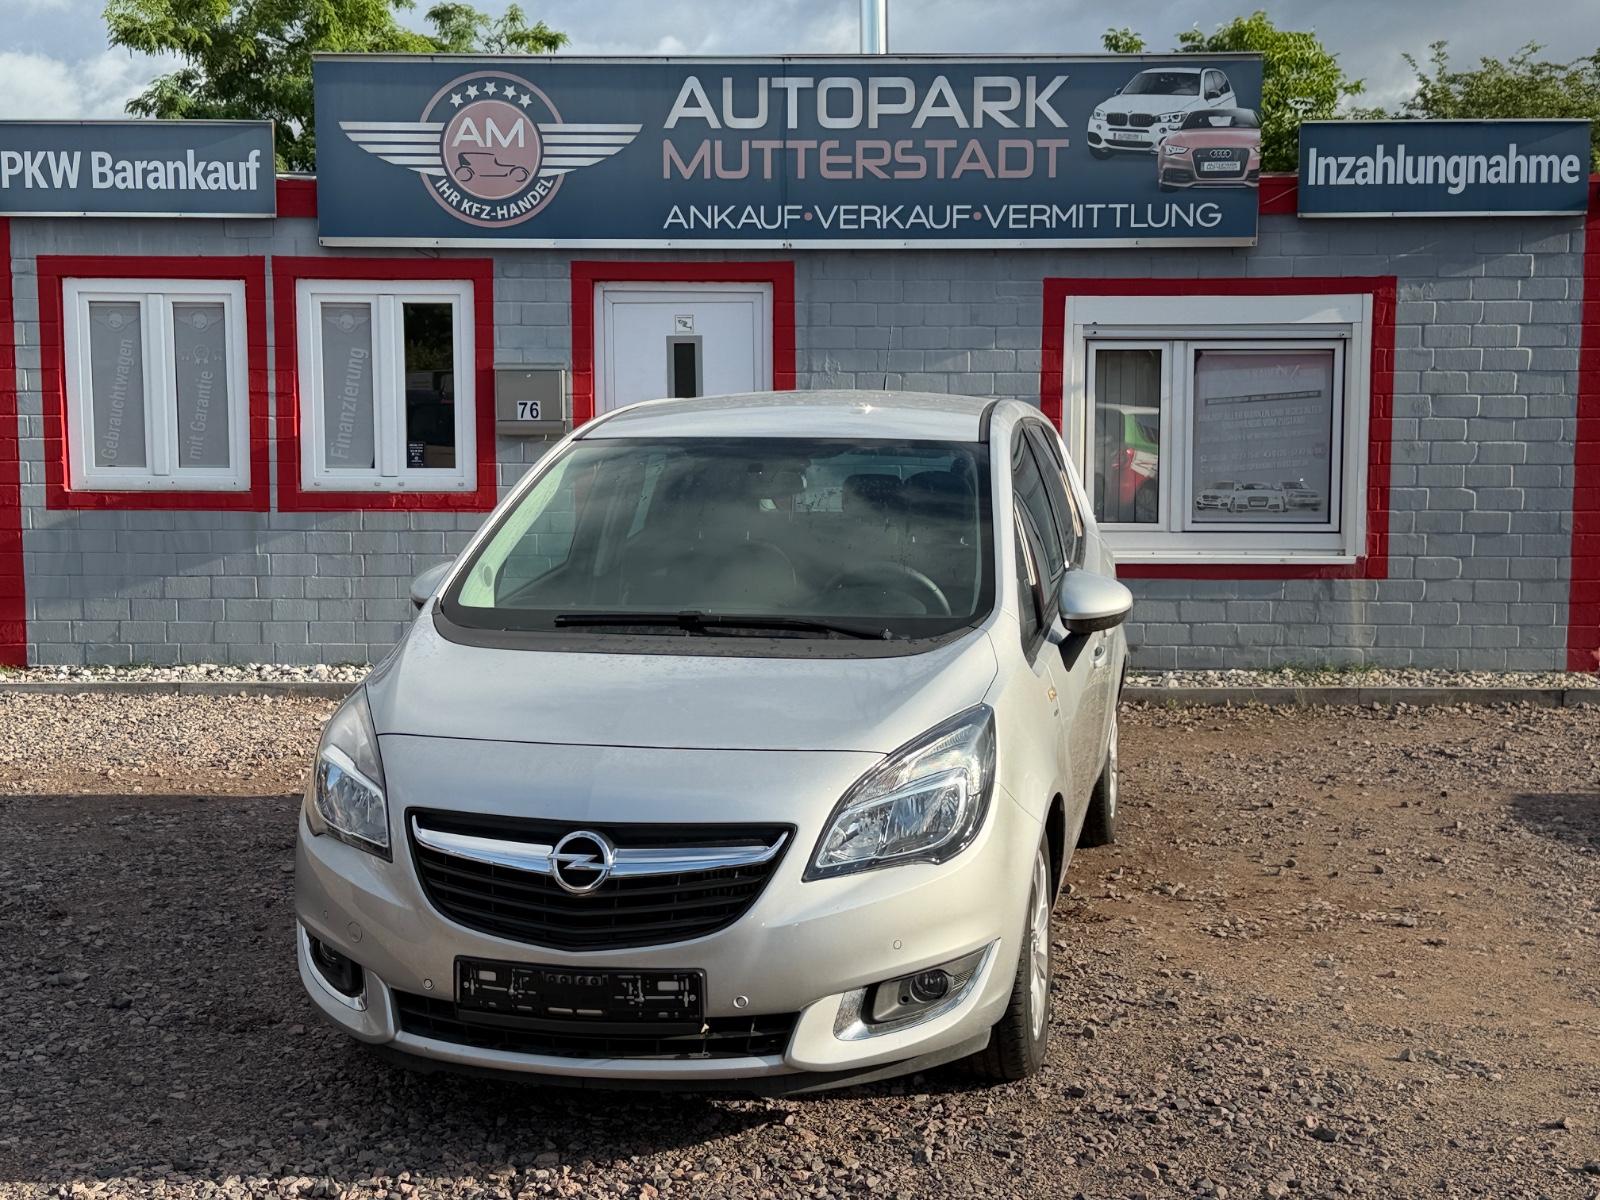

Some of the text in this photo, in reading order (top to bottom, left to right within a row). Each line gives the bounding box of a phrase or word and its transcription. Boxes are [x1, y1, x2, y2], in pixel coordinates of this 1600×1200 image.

[664, 75, 1069, 130] AUTOPARK
[451, 117, 526, 149] AM
[0, 149, 261, 191] PKW Barankauf
[663, 138, 1070, 180] MUTTERSTADT
[1307, 143, 1581, 195] Inzahlungnahme
[435, 178, 555, 219] IHR KFZ-HANDEL
[663, 202, 1222, 230] ANKAUF VERKAUF VERMITTLUNG
[101, 338, 135, 461] Gebrauchtwagen
[187, 369, 215, 461] mit Garantie
[328, 346, 370, 460] Finanzierung
[517, 401, 539, 419] 76
